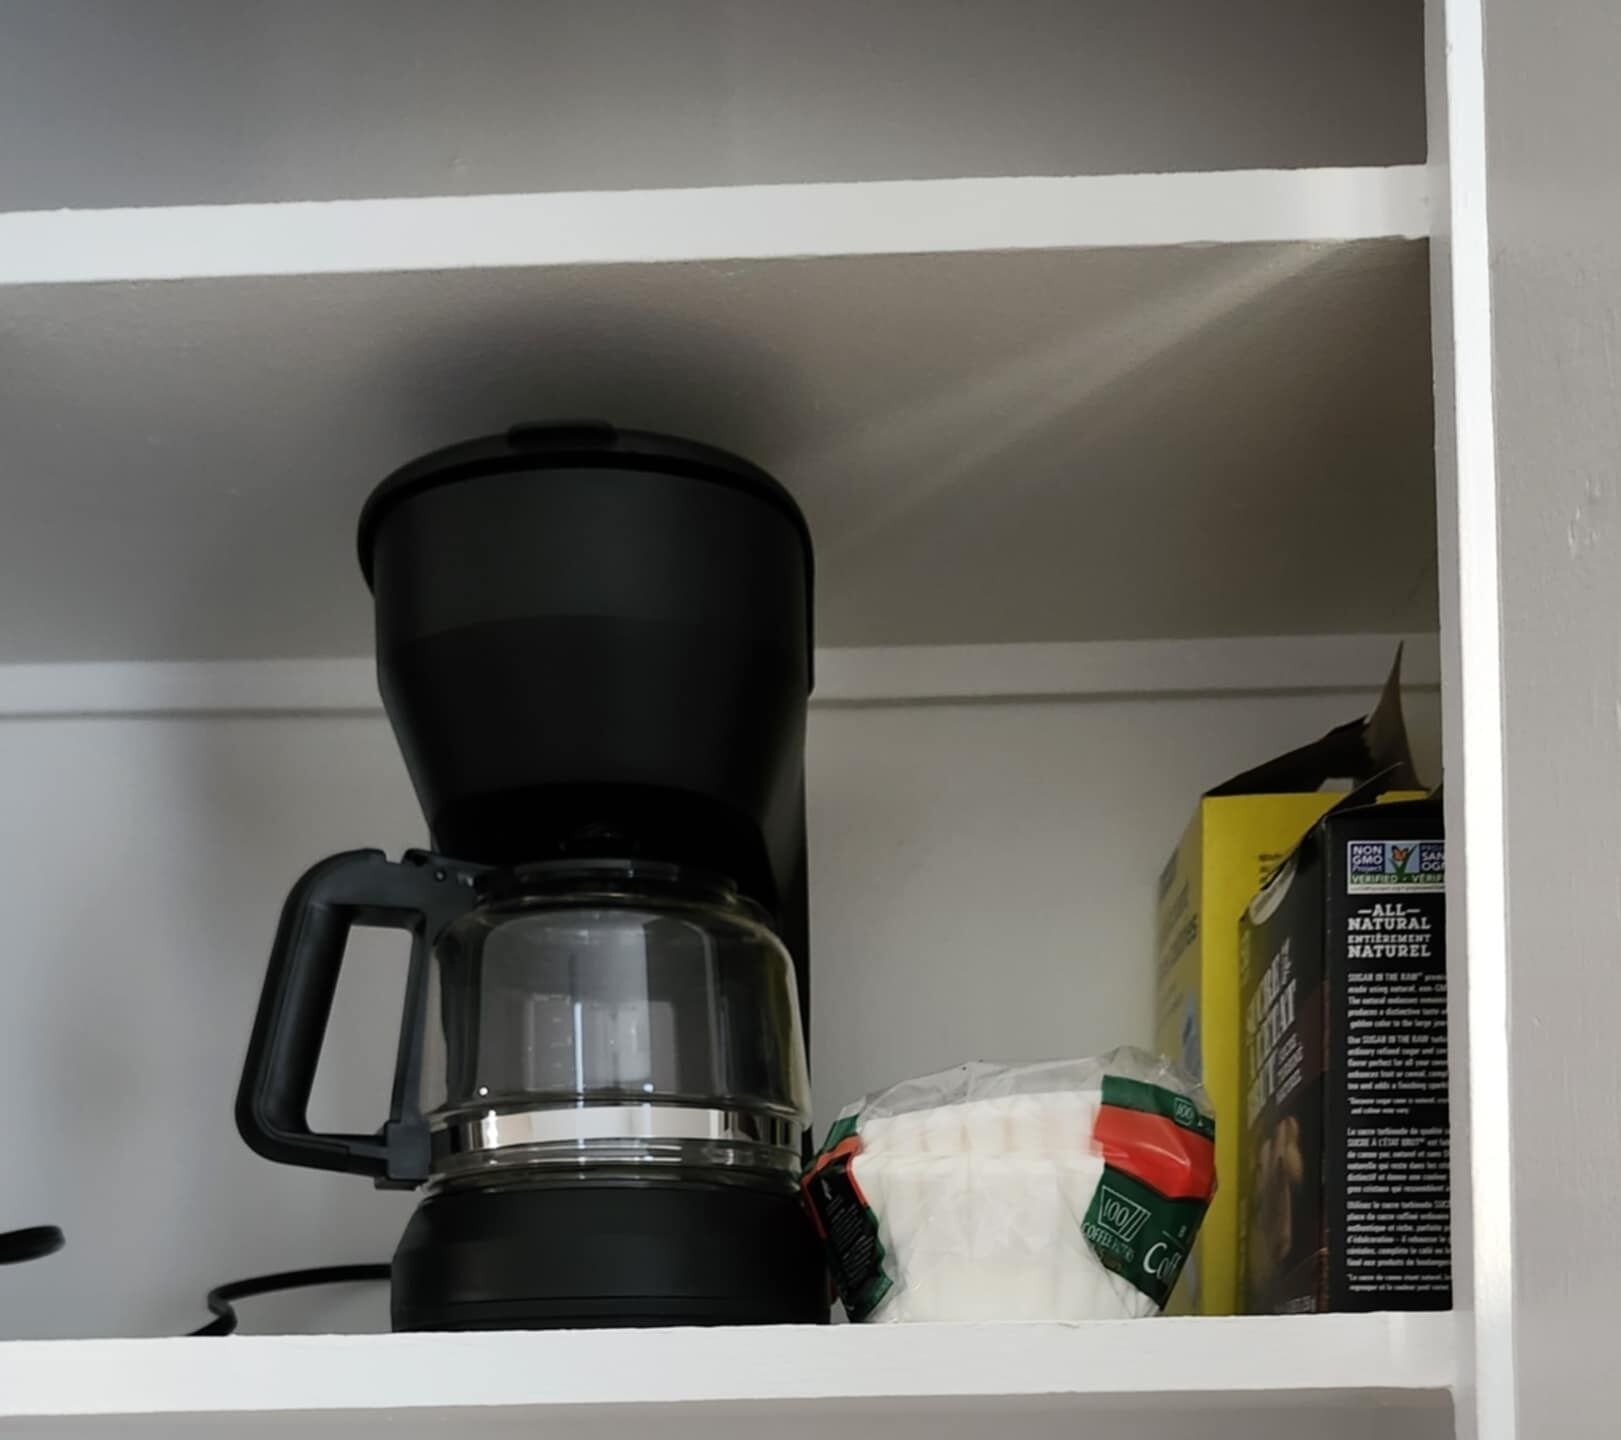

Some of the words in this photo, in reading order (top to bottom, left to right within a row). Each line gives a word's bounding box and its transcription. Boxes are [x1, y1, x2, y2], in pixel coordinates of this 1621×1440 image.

[1353, 845, 1382, 855] NON
[1352, 855, 1383, 865] GMO
[1422, 852, 1445, 861] SAN
[1423, 862, 1445, 872] OG
[1347, 917, 1432, 931] NATURAL
[1347, 944, 1432, 958] NATUREL
